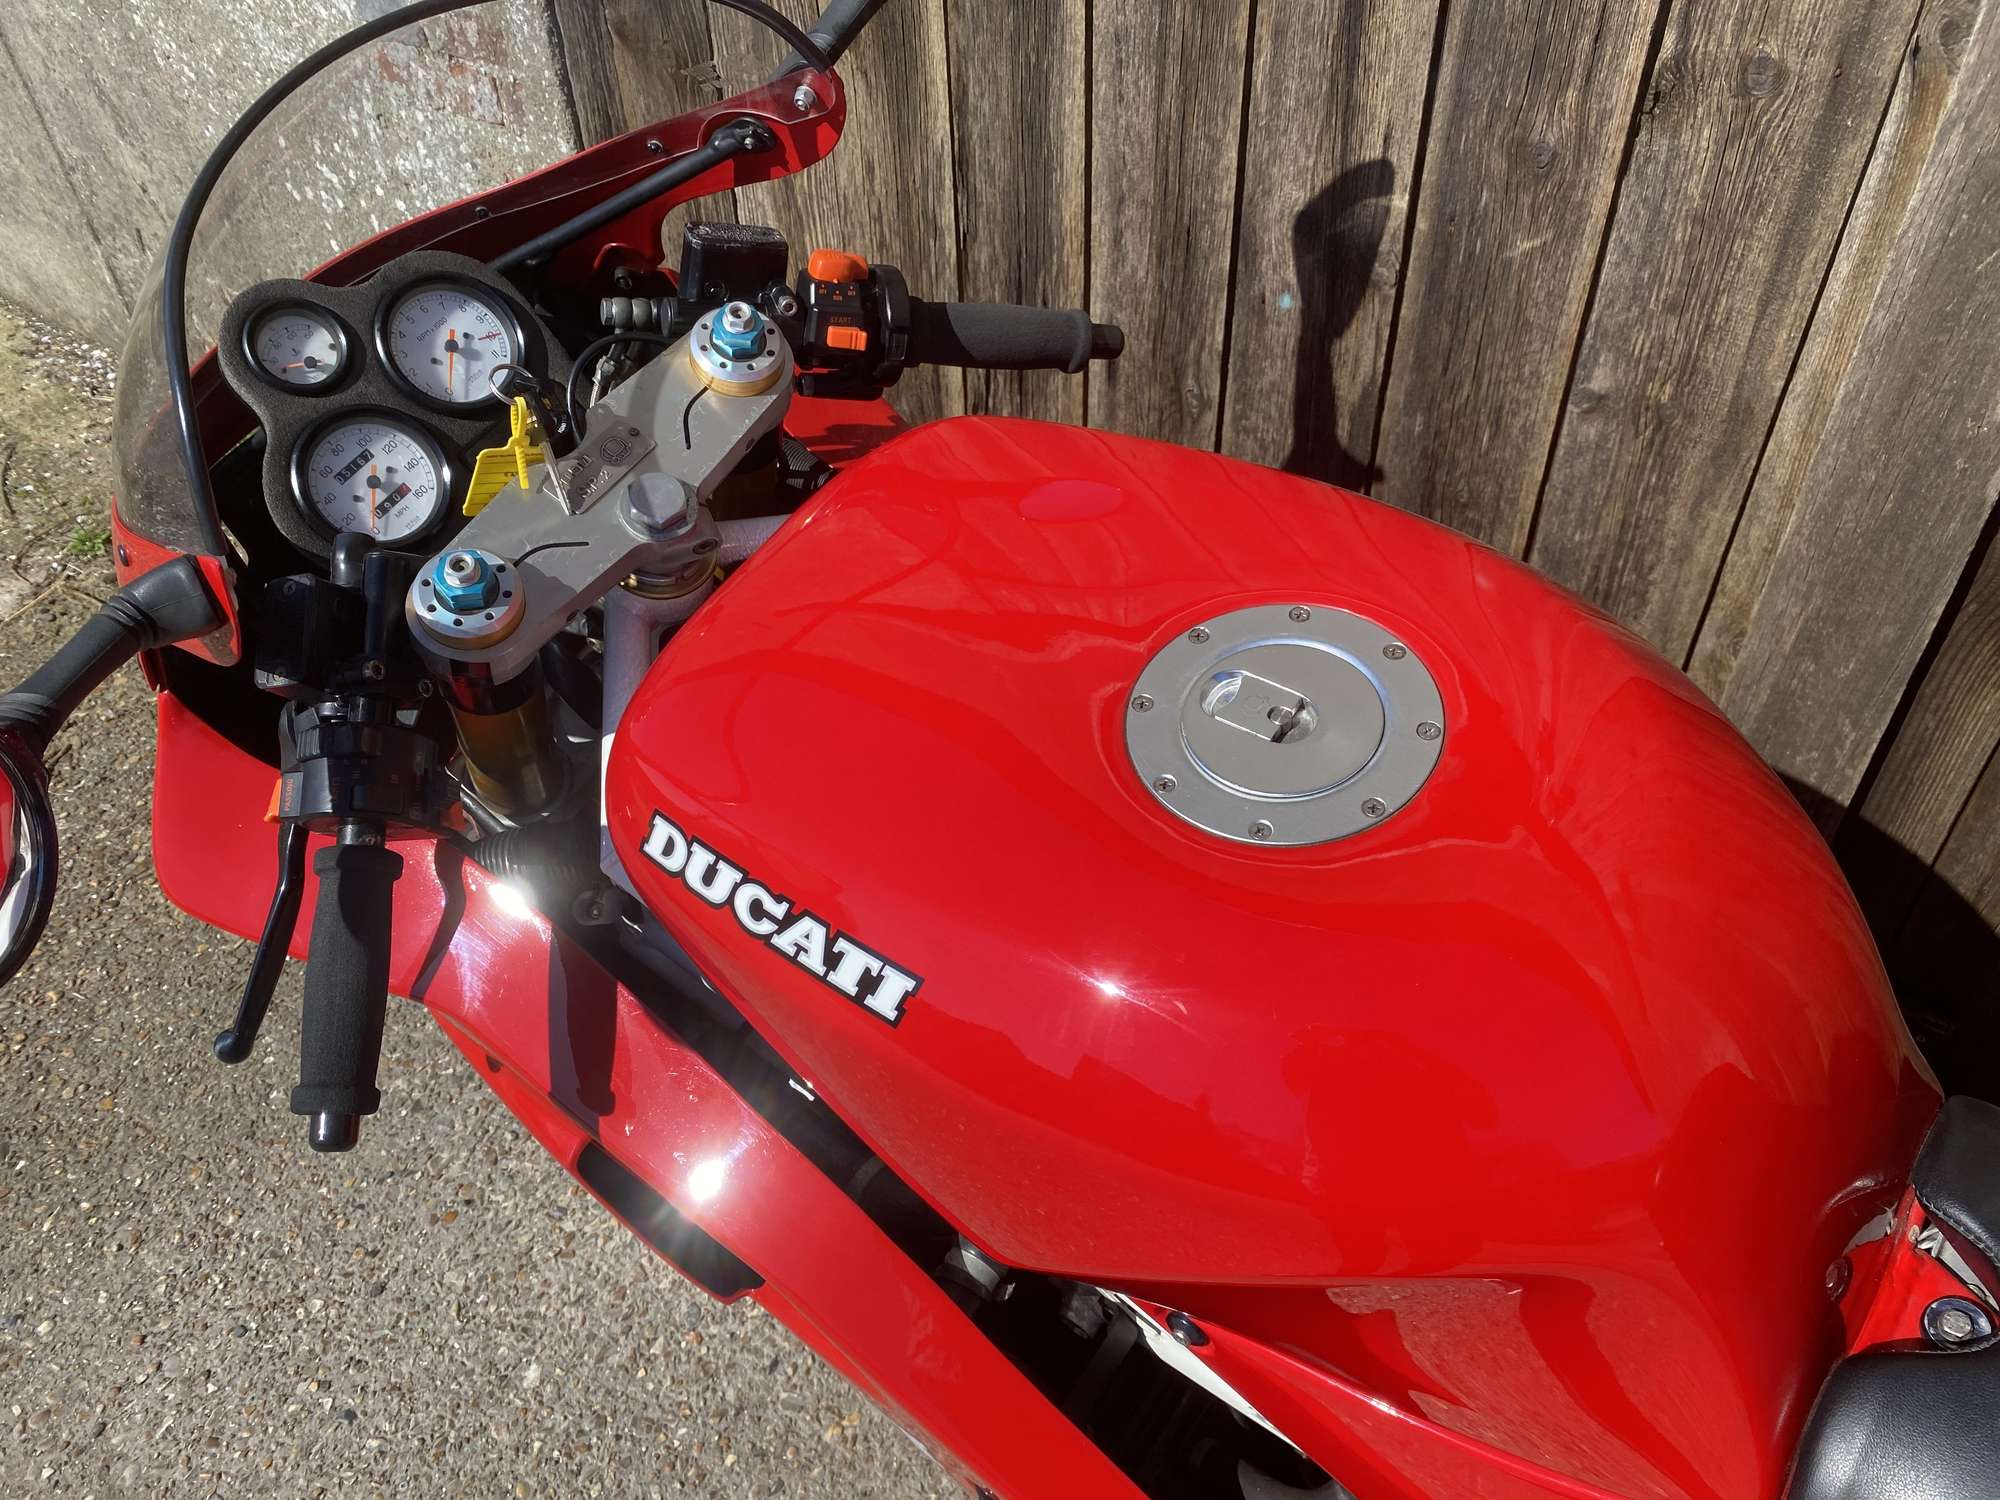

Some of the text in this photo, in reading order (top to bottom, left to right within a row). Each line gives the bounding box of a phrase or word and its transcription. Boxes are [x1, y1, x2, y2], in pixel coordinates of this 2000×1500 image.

[419, 305, 429, 313] 6
[459, 302, 467, 312] 8
[405, 314, 416, 325] 5
[475, 314, 485, 324] 9
[399, 330, 407, 339] 4
[408, 367, 418, 377] 2
[355, 434, 373, 449] 100
[381, 439, 398, 455] 120
[330, 443, 345, 457] 80
[319, 465, 333, 478] 60
[335, 449, 373, 484] 05167
[403, 457, 419, 473] 140
[323, 492, 337, 505] 40
[412, 485, 428, 500] 160
[342, 512, 356, 526] 20
[394, 505, 410, 519] MPH
[642, 812, 919, 1024] DUCATI
